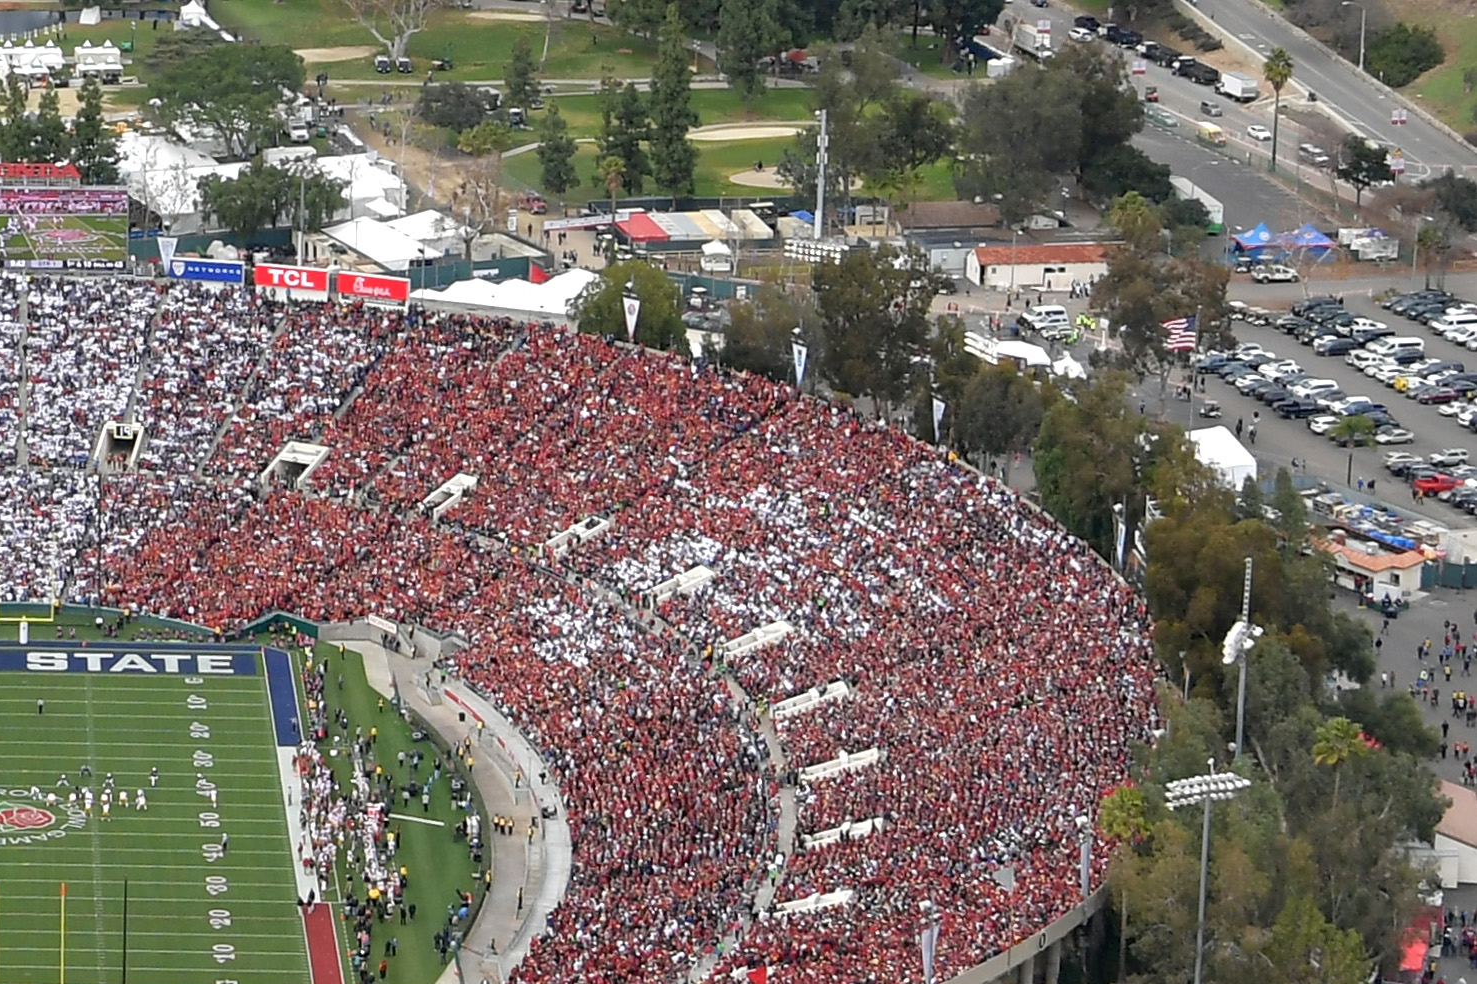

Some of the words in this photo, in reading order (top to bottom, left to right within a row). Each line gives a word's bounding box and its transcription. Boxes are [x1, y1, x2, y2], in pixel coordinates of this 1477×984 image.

[268, 268, 314, 288] TCL
[26, 652, 234, 675] STATE
[198, 812, 221, 828] 50
[205, 876, 228, 892] 30
[208, 909, 232, 926] 20
